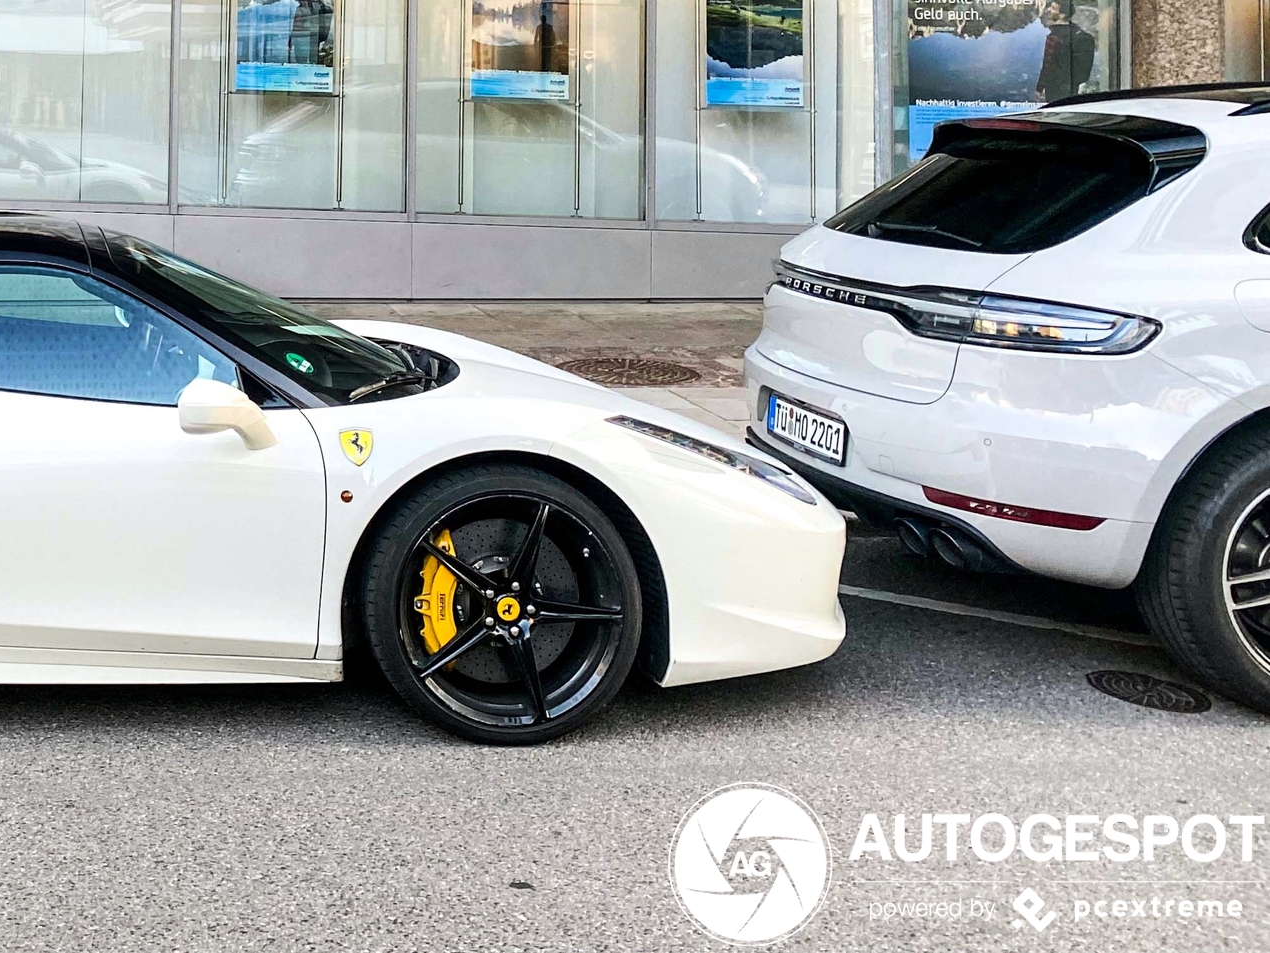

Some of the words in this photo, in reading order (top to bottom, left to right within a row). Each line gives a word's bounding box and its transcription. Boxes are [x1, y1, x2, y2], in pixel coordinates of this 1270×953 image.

[914, 8, 943, 20] Geld
[947, 8, 983, 21] auch.
[915, 98, 956, 108] Nachhaltig
[785, 277, 866, 305] PORSCHE
[810, 418, 841, 456] 2201
